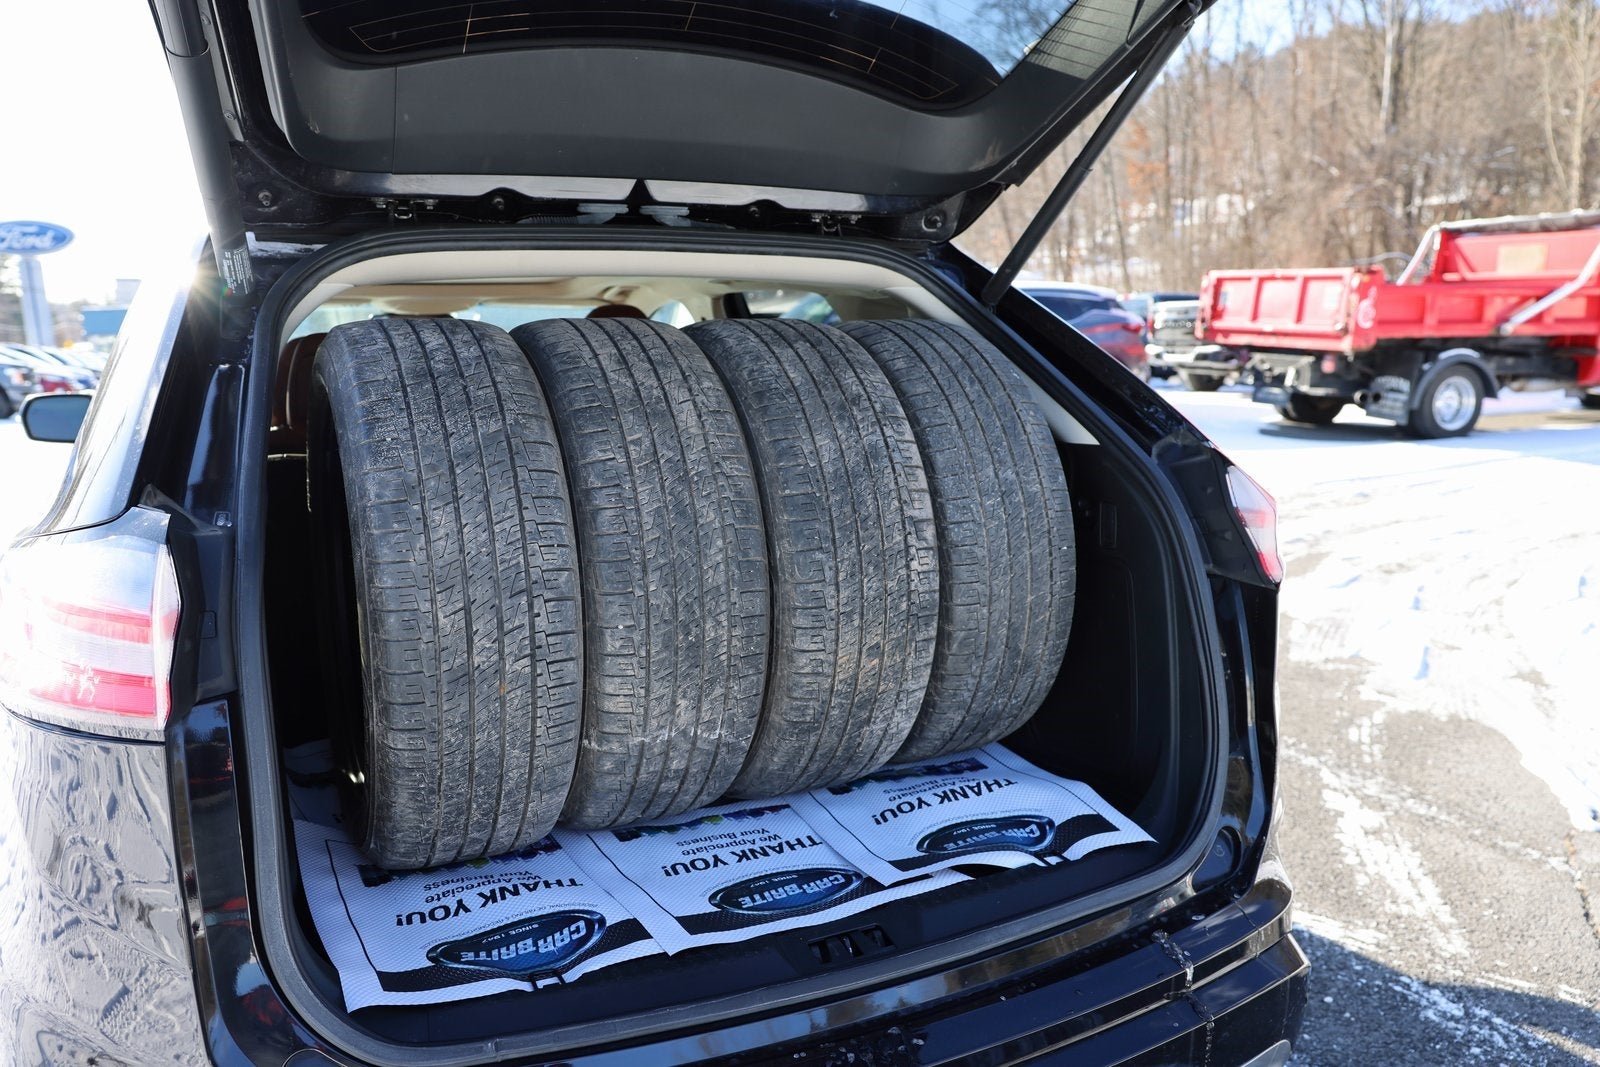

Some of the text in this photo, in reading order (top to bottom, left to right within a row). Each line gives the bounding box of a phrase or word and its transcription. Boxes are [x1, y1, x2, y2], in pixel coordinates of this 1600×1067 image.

[933, 779, 1017, 805] THANK
[872, 796, 932, 825] YOU!
[676, 828, 770, 847] Your Business
[1002, 823, 1040, 840] CAR
[681, 833, 782, 857] We Appreciate
[730, 835, 822, 865] THANK
[661, 854, 730, 877] YOU!
[424, 877, 515, 905] Appreciate
[738, 884, 802, 908] BRITE
[802, 874, 845, 894] CAR
[396, 878, 583, 926] THANK YOU!
[509, 923, 539, 935] SINCE
[537, 920, 587, 954] CAR
[460, 936, 535, 962] BRITE
